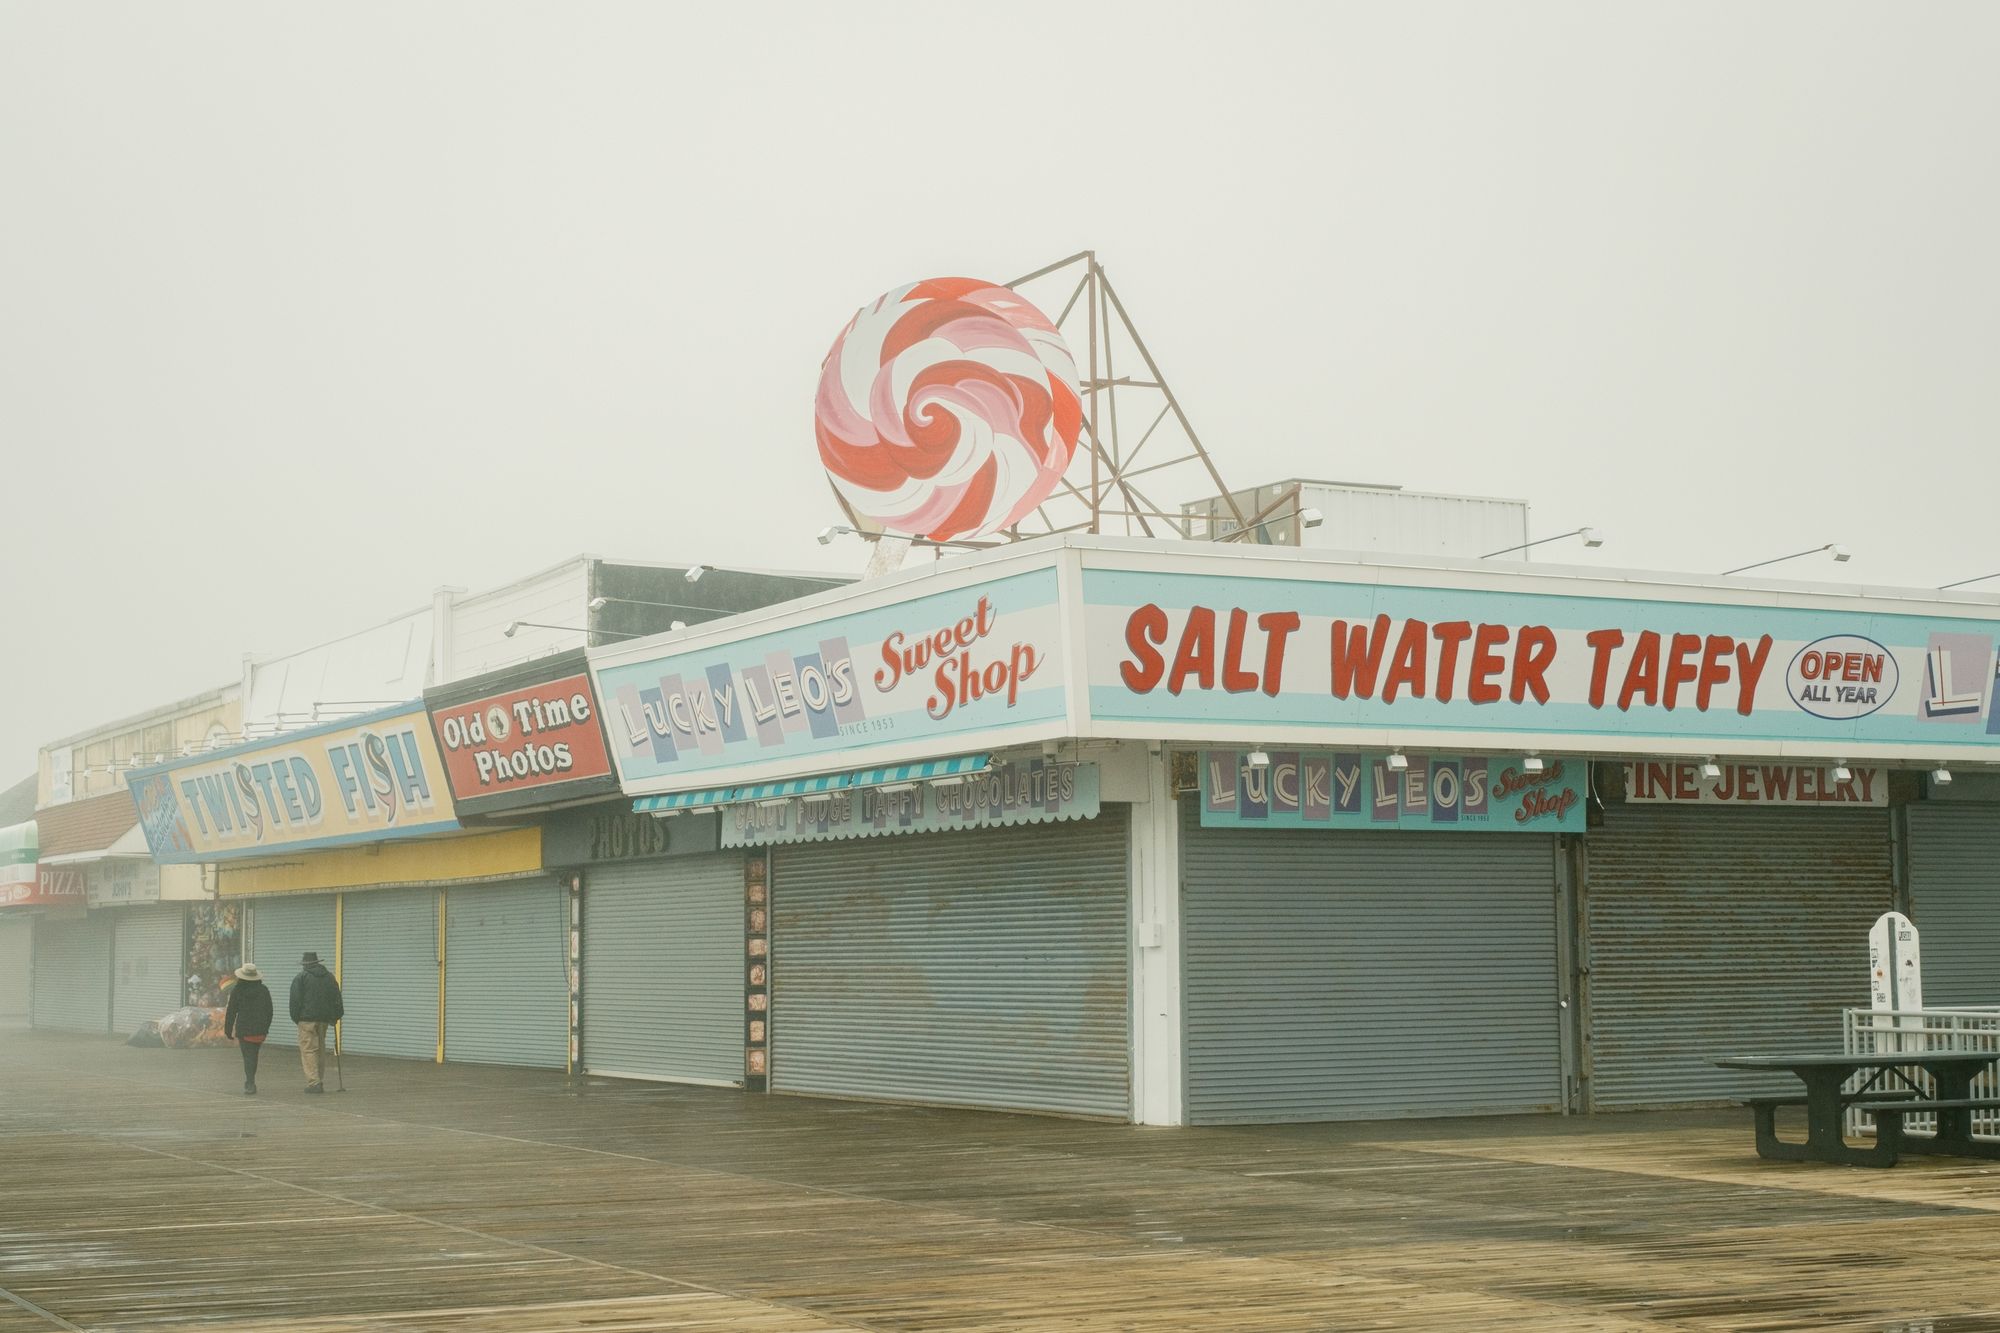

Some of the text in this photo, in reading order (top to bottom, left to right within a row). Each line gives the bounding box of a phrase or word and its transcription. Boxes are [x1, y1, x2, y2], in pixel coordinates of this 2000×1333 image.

[874, 594, 998, 693] Sweet
[1120, 603, 1774, 717] SALT WATER TAFFY
[1800, 650, 1885, 683] OPEN
[748, 656, 853, 723] LEO'S
[926, 641, 1046, 721] Shop
[1800, 684, 1877, 704] ALL YEAR
[443, 693, 592, 750] Old Time
[840, 716, 896, 737] SINCE 1953
[181, 756, 323, 841] TWISTED
[327, 729, 431, 823] FISH
[474, 742, 573, 785] Photos
[1374, 761, 1488, 808] LEO'S
[1711, 765, 1877, 803] JEWELRY
[864, 784, 924, 819] TAFFY
[936, 766, 1073, 812] CHOCOLATES
[1515, 787, 1579, 823] Shop
[40, 871, 86, 896] PIZZA
